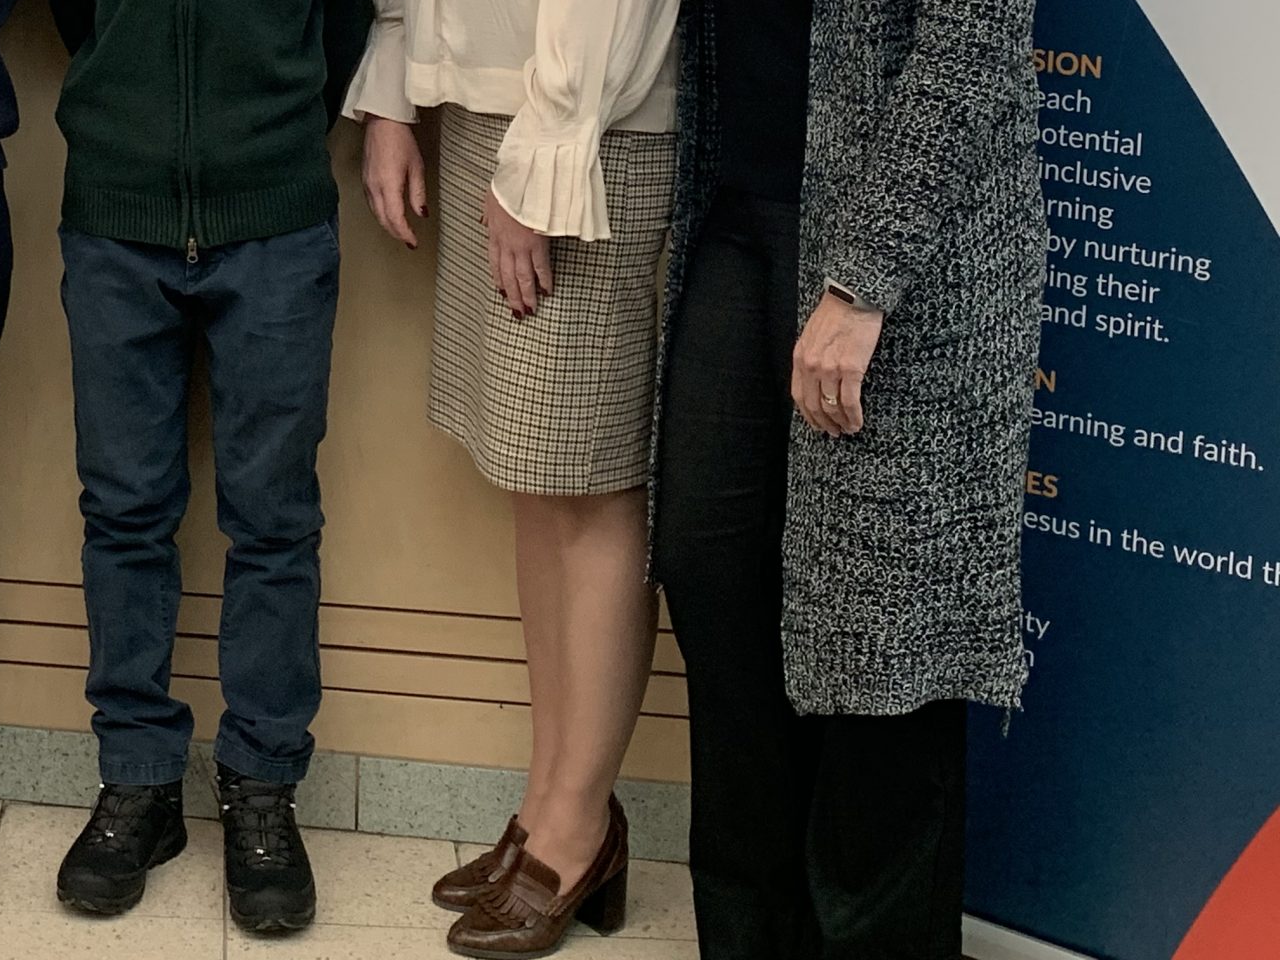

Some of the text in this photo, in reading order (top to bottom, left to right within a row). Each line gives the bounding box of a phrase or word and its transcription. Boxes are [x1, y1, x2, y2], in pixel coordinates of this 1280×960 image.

[1036, 89, 1091, 114] each
[1037, 124, 1143, 157] otential
[1038, 155, 1152, 194] inclusive
[1046, 227, 1212, 282] by nurturing
[1042, 264, 1161, 304] ing their
[1040, 300, 1169, 344] and spirit.
[1030, 406, 1264, 472] earning and faith.
[1023, 510, 1081, 540] esus
[1088, 519, 1113, 548] in
[1120, 528, 1166, 559] the
[1173, 544, 1254, 581] world
